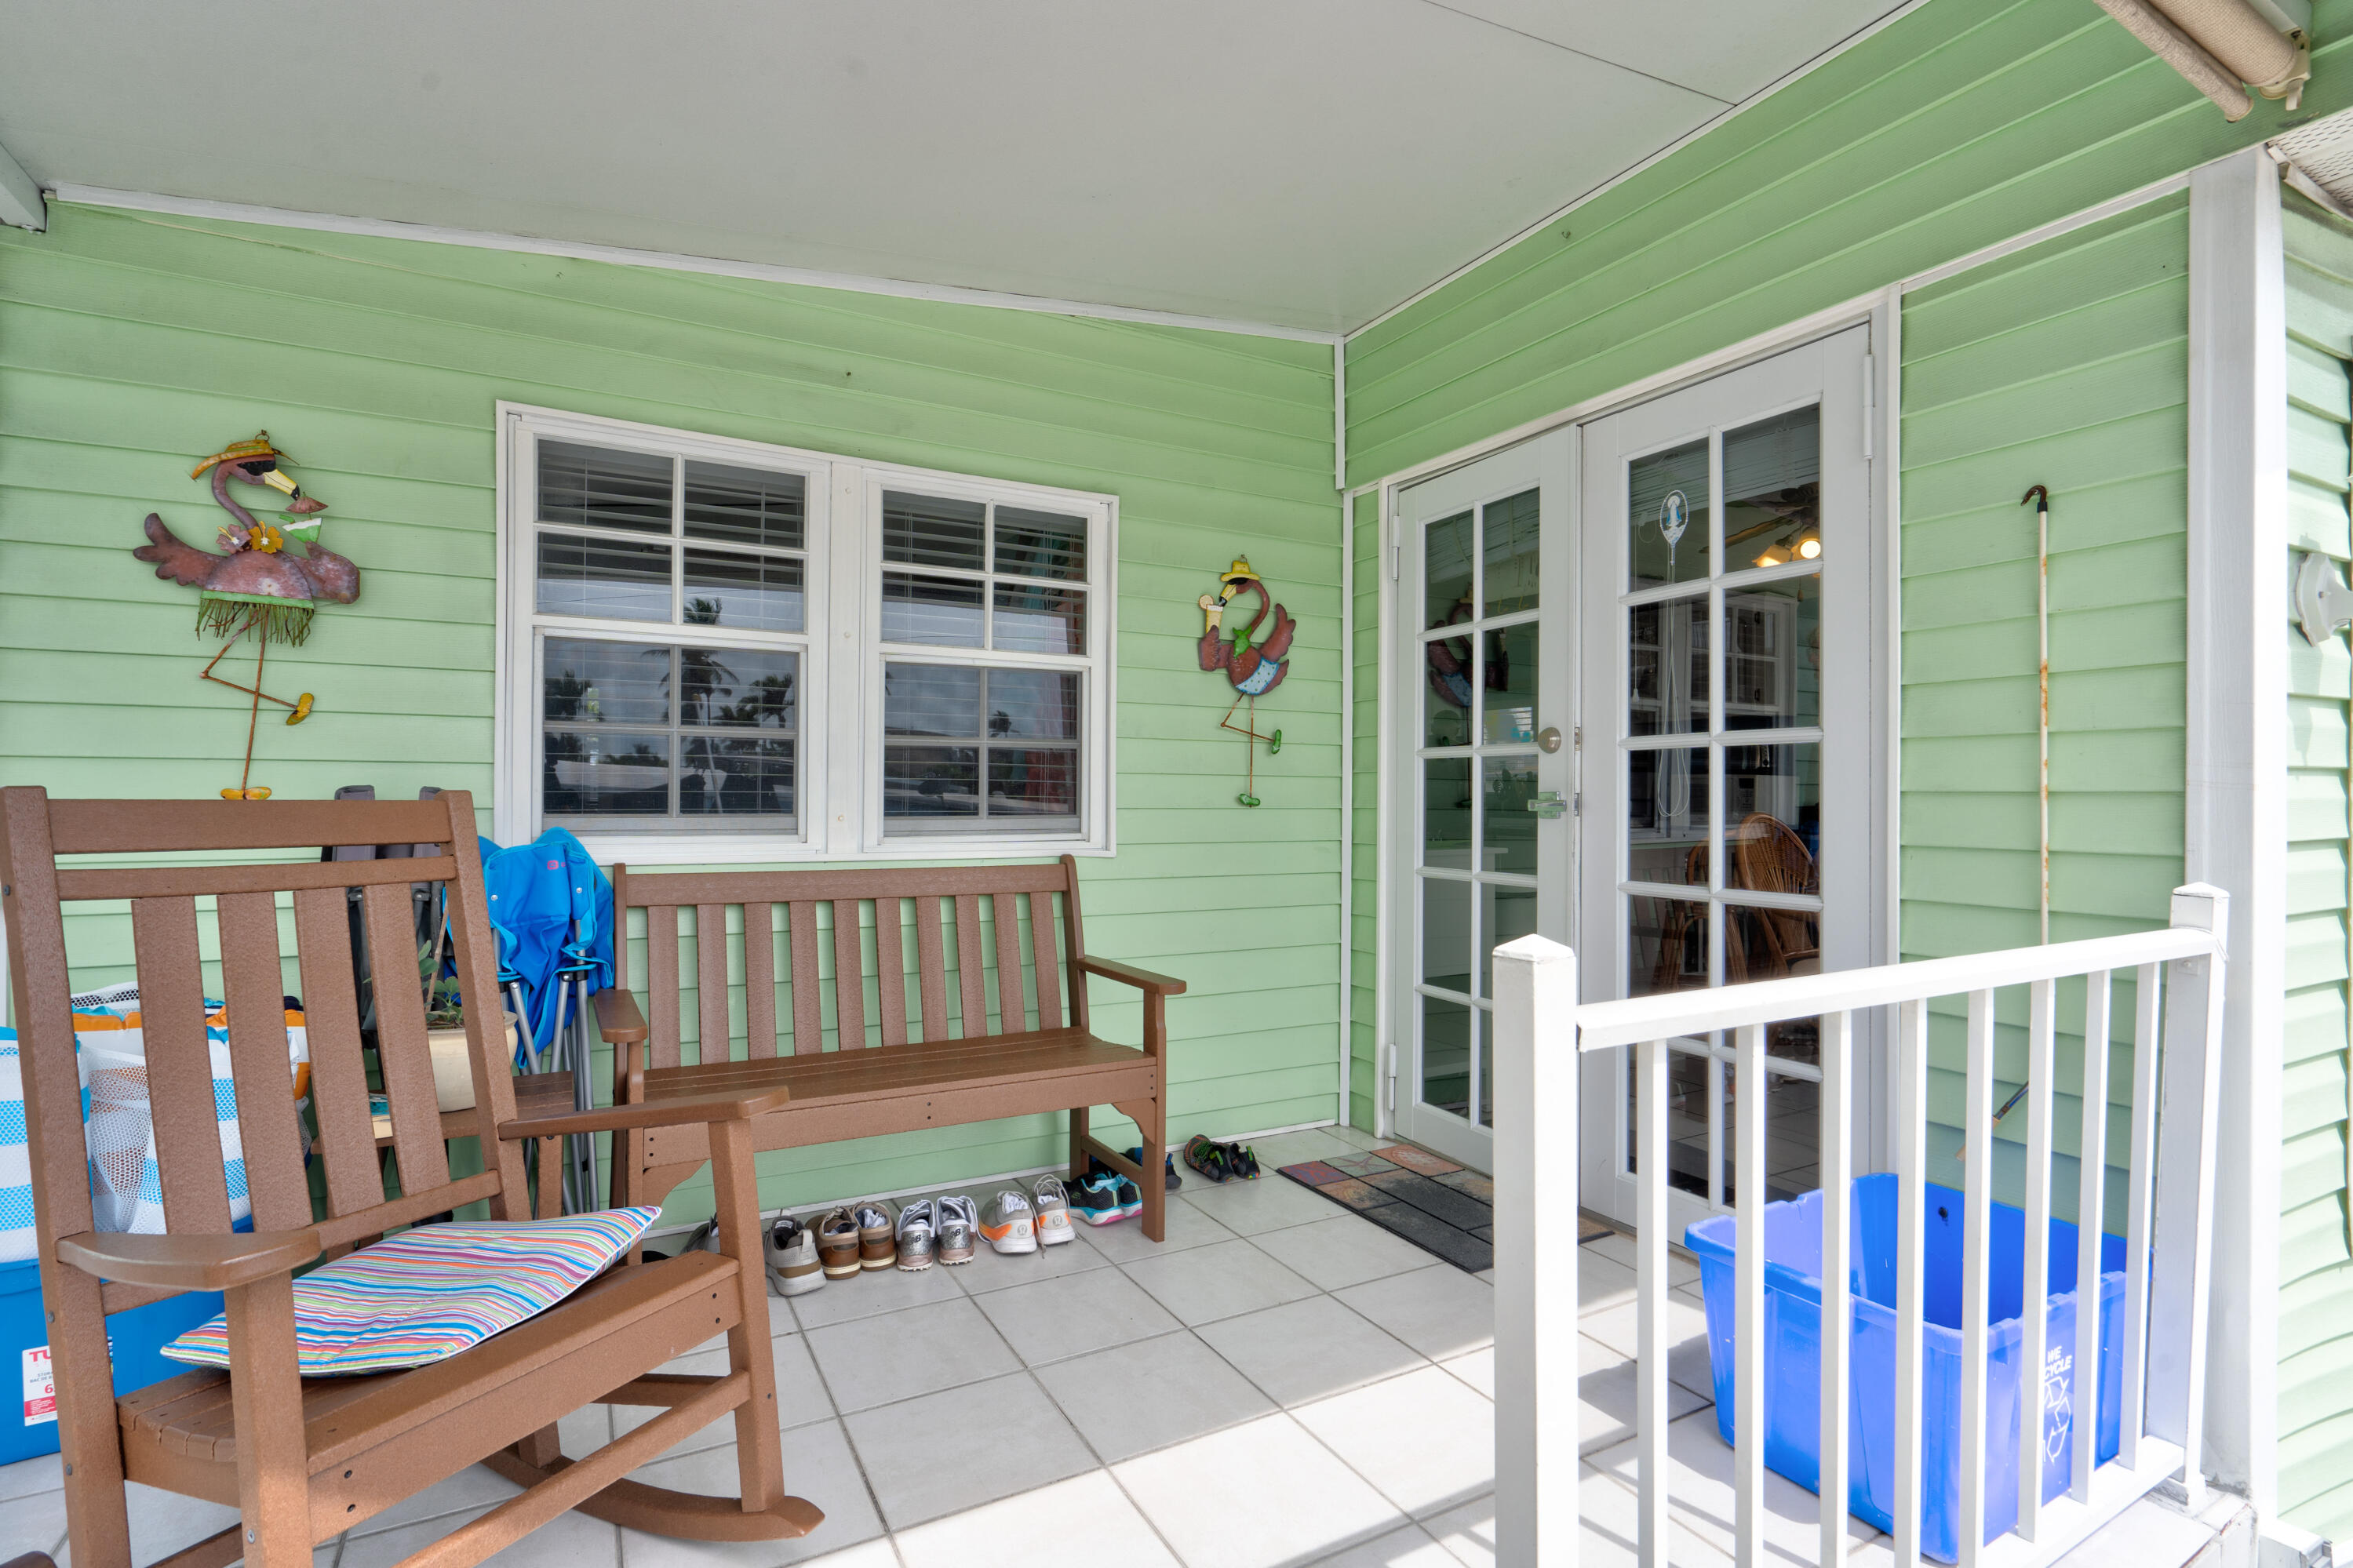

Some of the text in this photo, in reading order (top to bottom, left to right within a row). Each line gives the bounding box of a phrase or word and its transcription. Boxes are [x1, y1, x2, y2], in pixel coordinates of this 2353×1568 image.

[29, 1349, 51, 1362] TU
[2048, 1345, 2062, 1363] WE
[2045, 1355, 2073, 1379] CYCLE
[45, 1384, 55, 1393] 6
